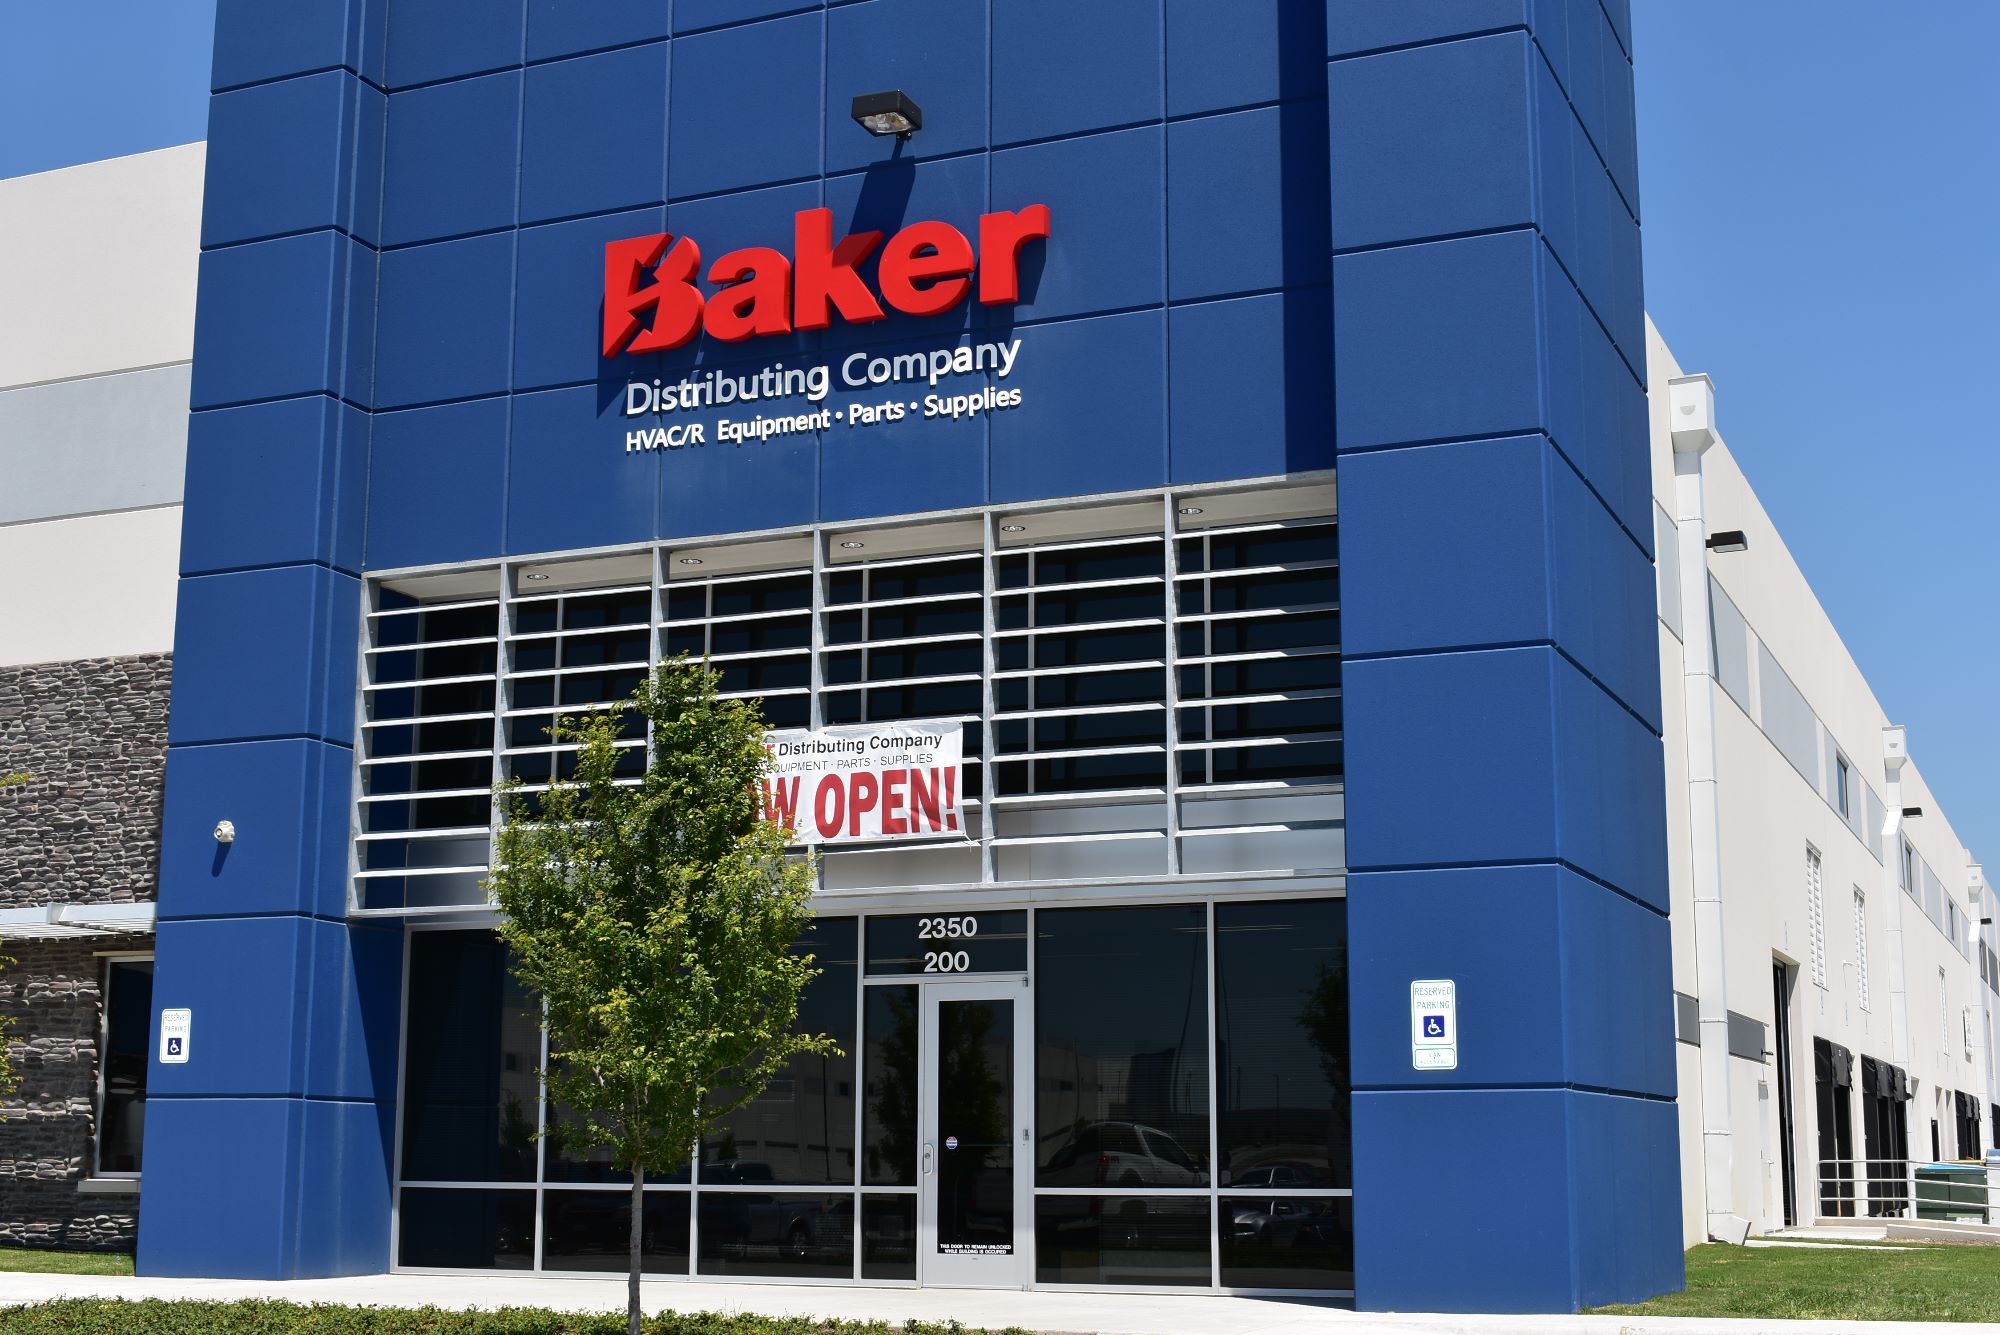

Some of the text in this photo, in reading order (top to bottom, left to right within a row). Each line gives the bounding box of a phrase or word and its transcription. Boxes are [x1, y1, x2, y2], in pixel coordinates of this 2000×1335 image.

[602, 203, 1050, 358] Baker
[626, 339, 1022, 415] Distributing Company
[626, 387, 1022, 452] HVAC/R Equipment Parts Supplies
[778, 739, 865, 756] Distributing
[869, 735, 943, 751] Company
[766, 753, 933, 774] QUIPMENT PARTS SUPPLIES
[814, 765, 958, 839] OPEN!
[918, 916, 978, 939] 2350
[923, 951, 970, 973] 200
[1414, 987, 1452, 997] RESERVED
[1416, 1001, 1450, 1010] PARKING
